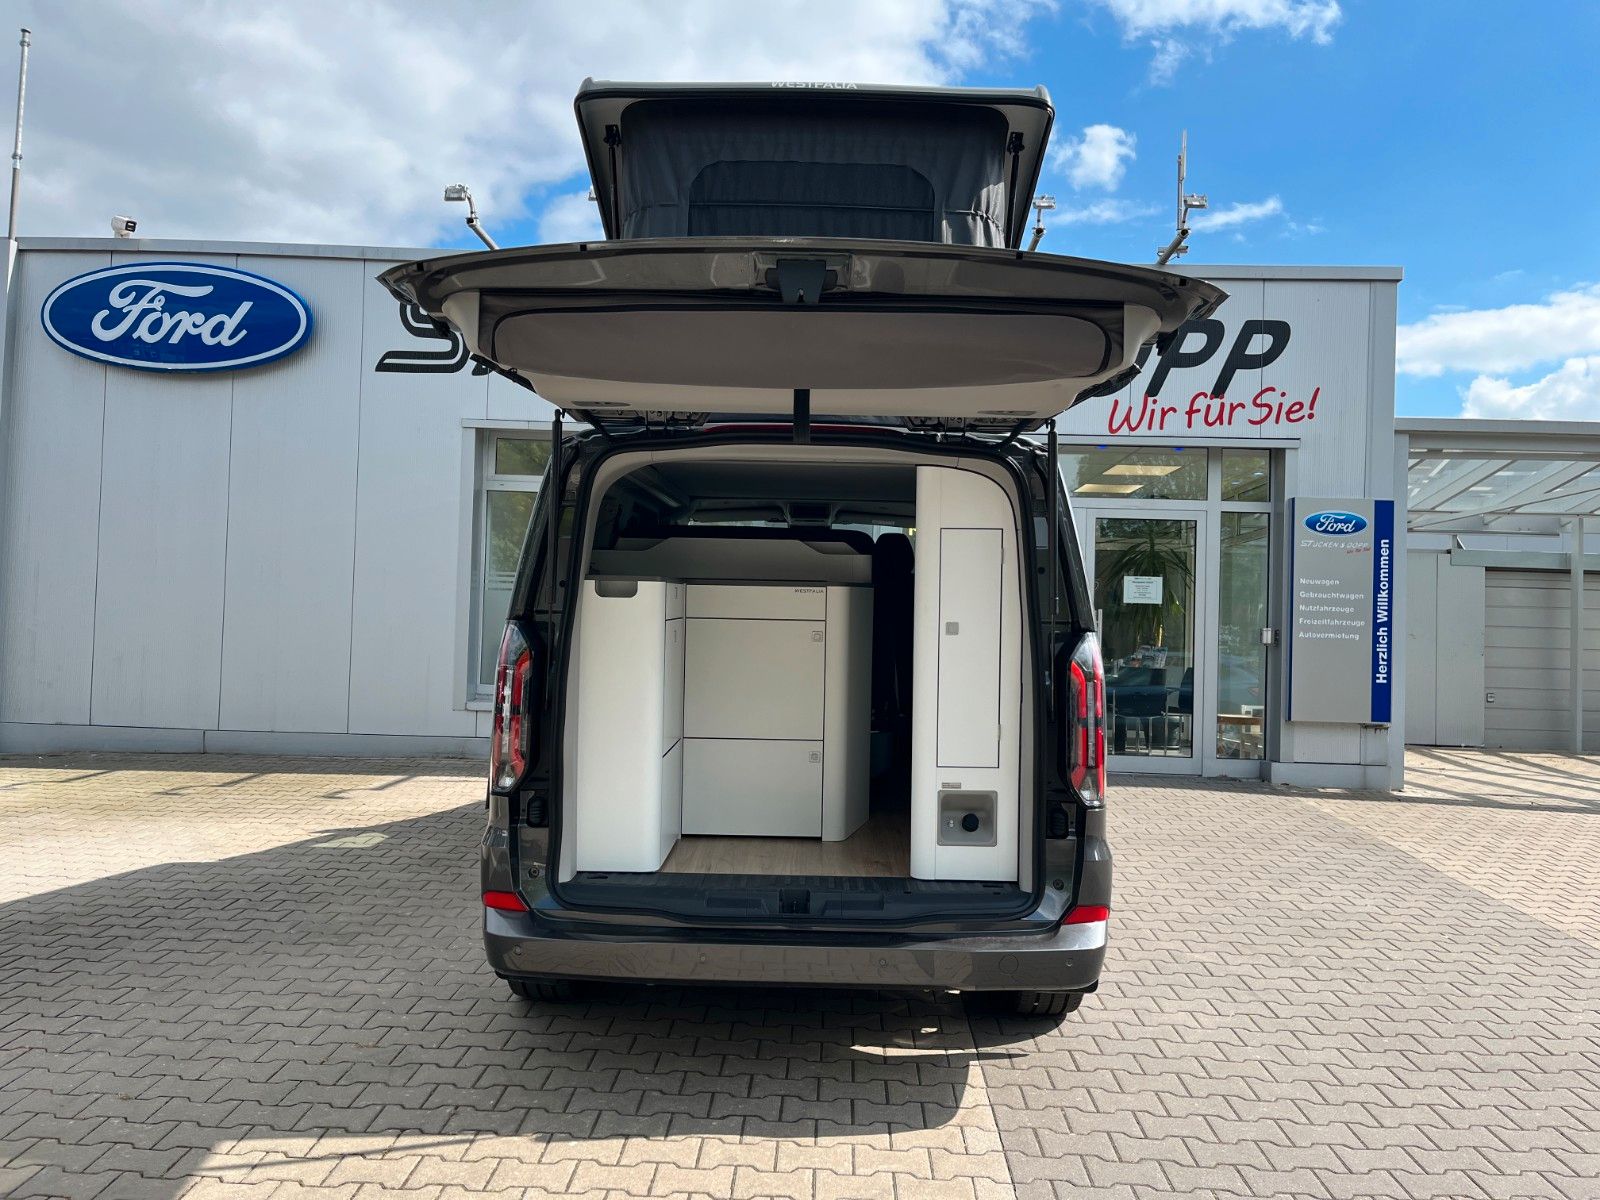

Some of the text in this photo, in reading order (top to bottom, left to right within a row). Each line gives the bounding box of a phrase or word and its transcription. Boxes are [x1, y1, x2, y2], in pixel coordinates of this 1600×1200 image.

[92, 280, 254, 347] Ford
[1108, 387, 1321, 434] Wir für Sie!
[1315, 514, 1356, 533] Ford
[1299, 578, 1340, 586] Neuwagen
[1299, 591, 1364, 600] Gebrauchtwagen
[1299, 604, 1355, 613] Nutzfahrzeuge
[1375, 539, 1390, 684] Herzlich Willkommen
[1298, 617, 1365, 627] Freizeitfahrzeuge
[1298, 631, 1360, 640] Autovermietung
